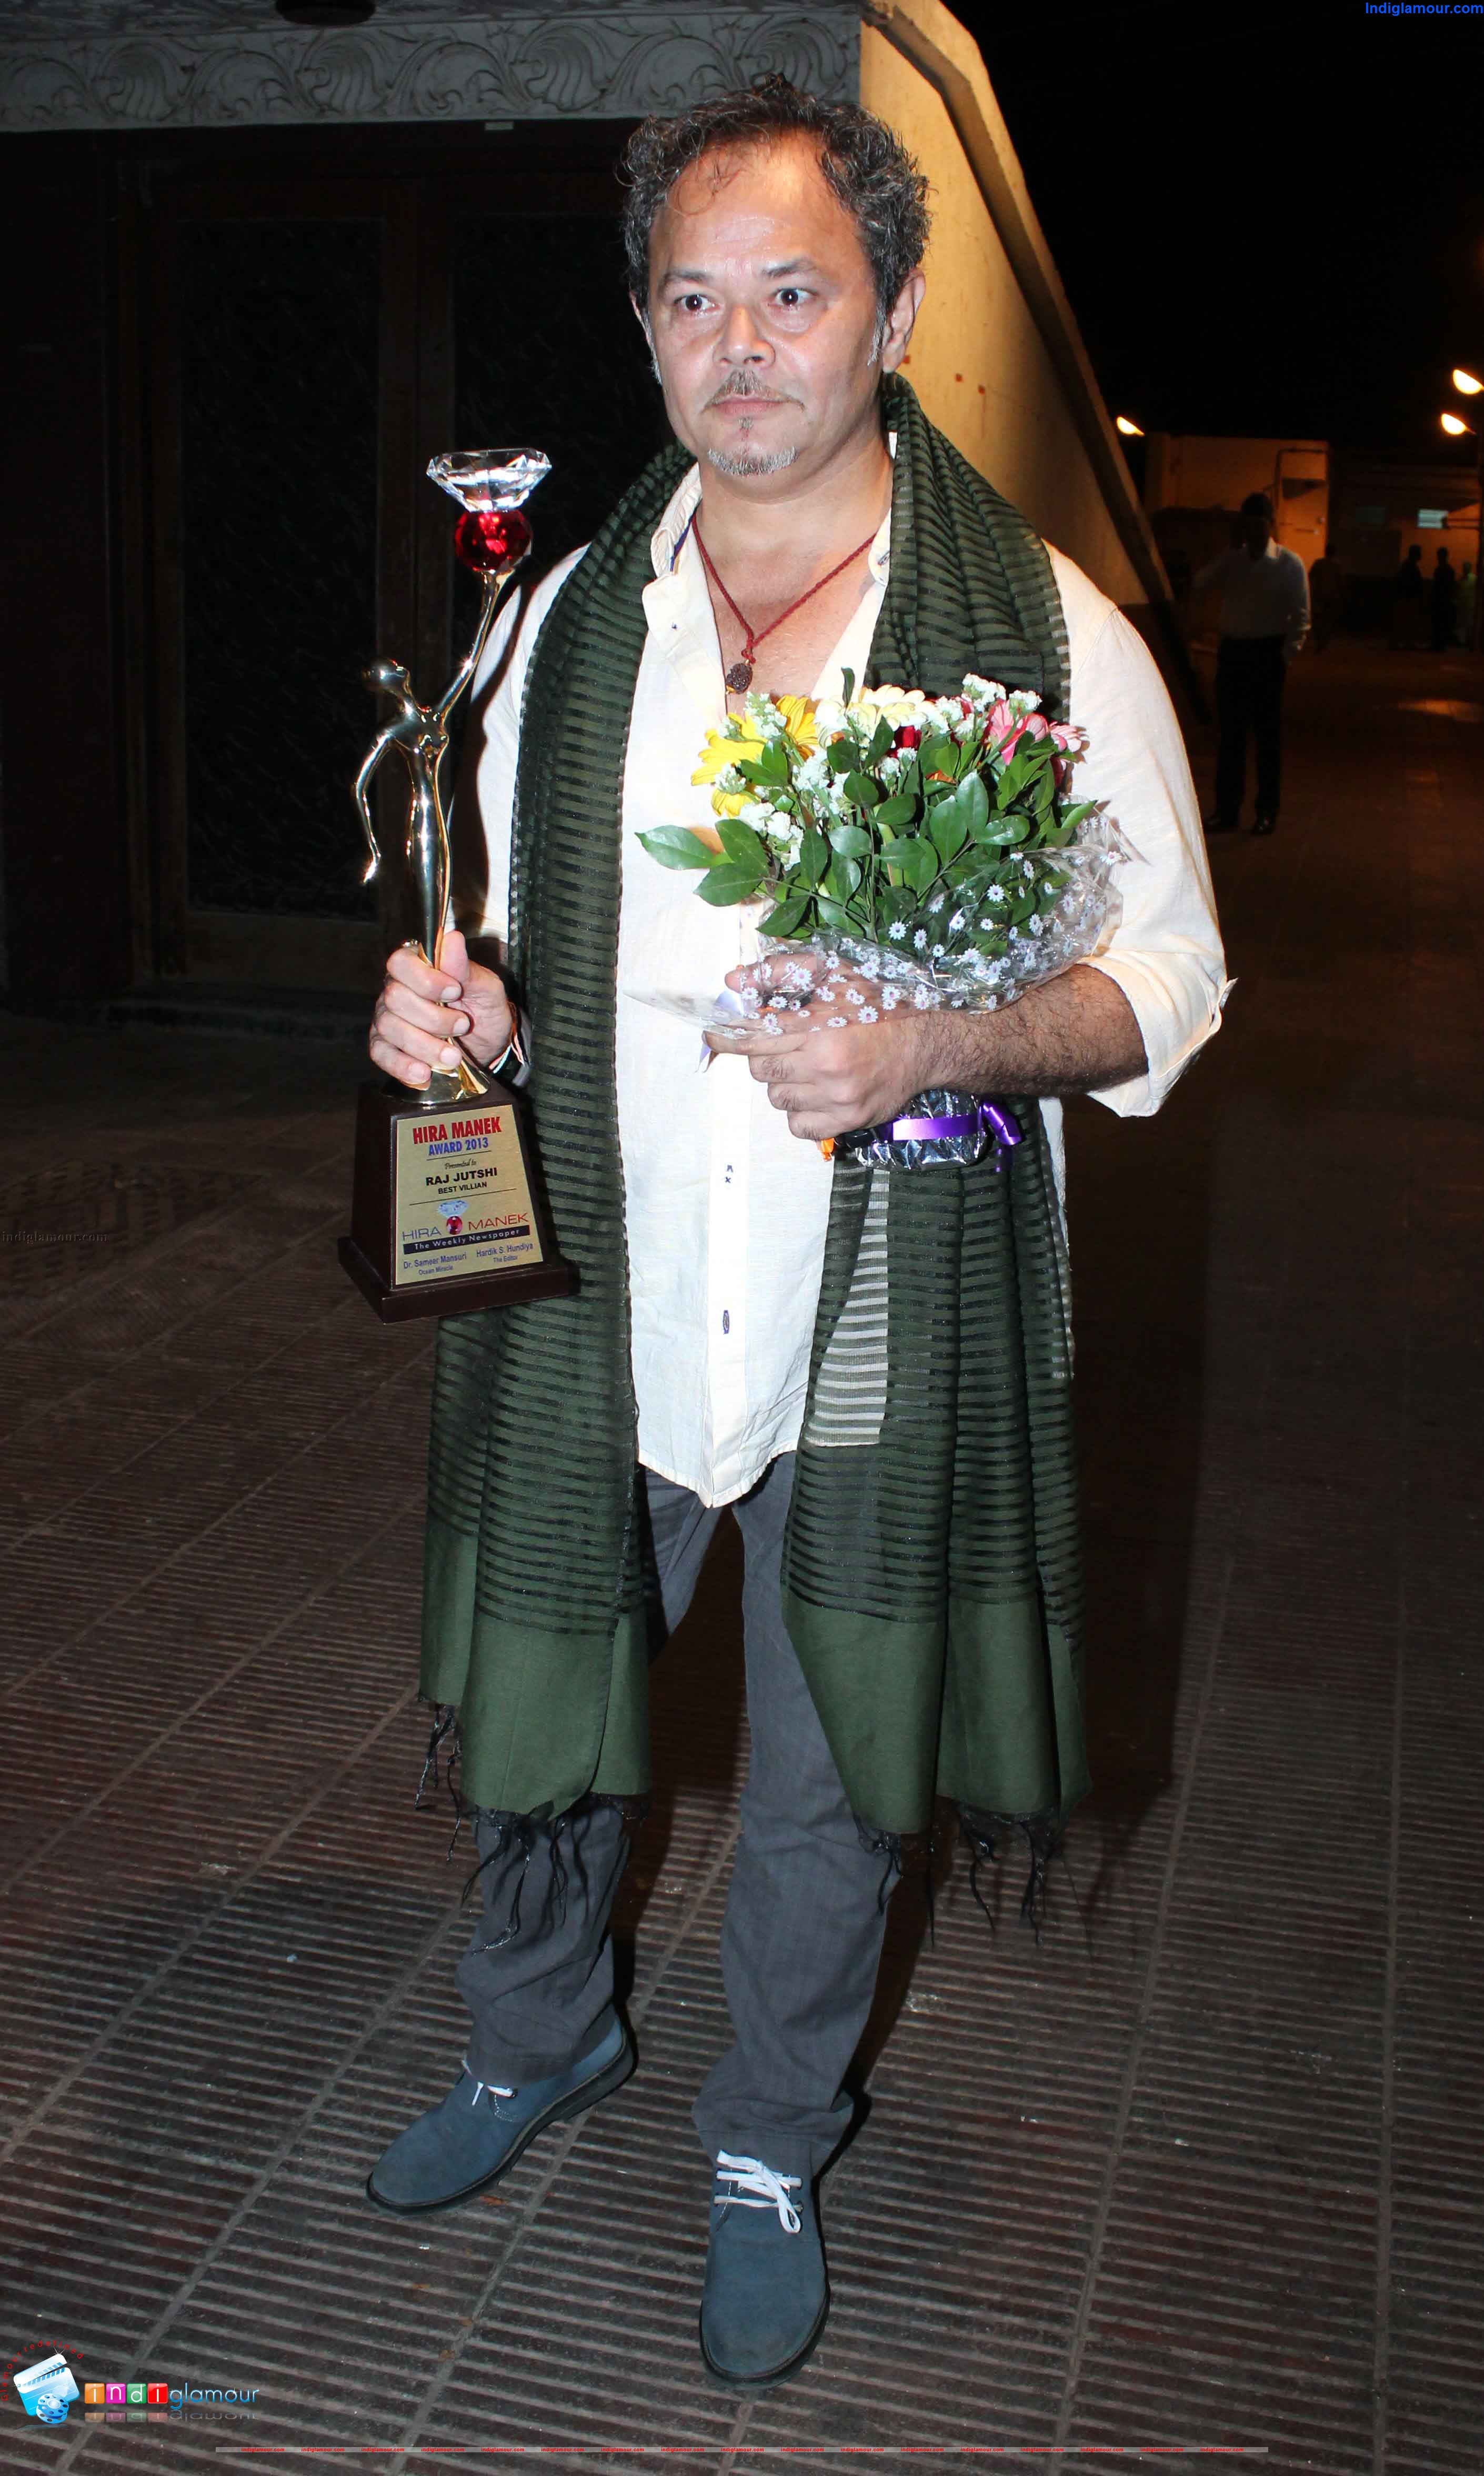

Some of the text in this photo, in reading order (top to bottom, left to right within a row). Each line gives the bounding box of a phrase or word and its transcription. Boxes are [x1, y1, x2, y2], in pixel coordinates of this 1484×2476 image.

[413, 1116, 502, 1144] HIRA MANEK
[428, 1137, 488, 1156] AWARD 2013
[444, 1159, 472, 1170] Presented
[426, 1167, 497, 1186] RAJ JUTSHI
[438, 1182, 487, 1194] BEST VILLIAN
[402, 1212, 529, 1241] HIRA MANEK
[433, 1237, 466, 1247] Weekly
[469, 1229, 520, 1242] Newspaper
[476, 1247, 497, 1257] Hardik
[507, 1242, 534, 1253] Hundiya
[414, 1258, 439, 1267] Sameer
[440, 1252, 467, 1263] Mansuri
